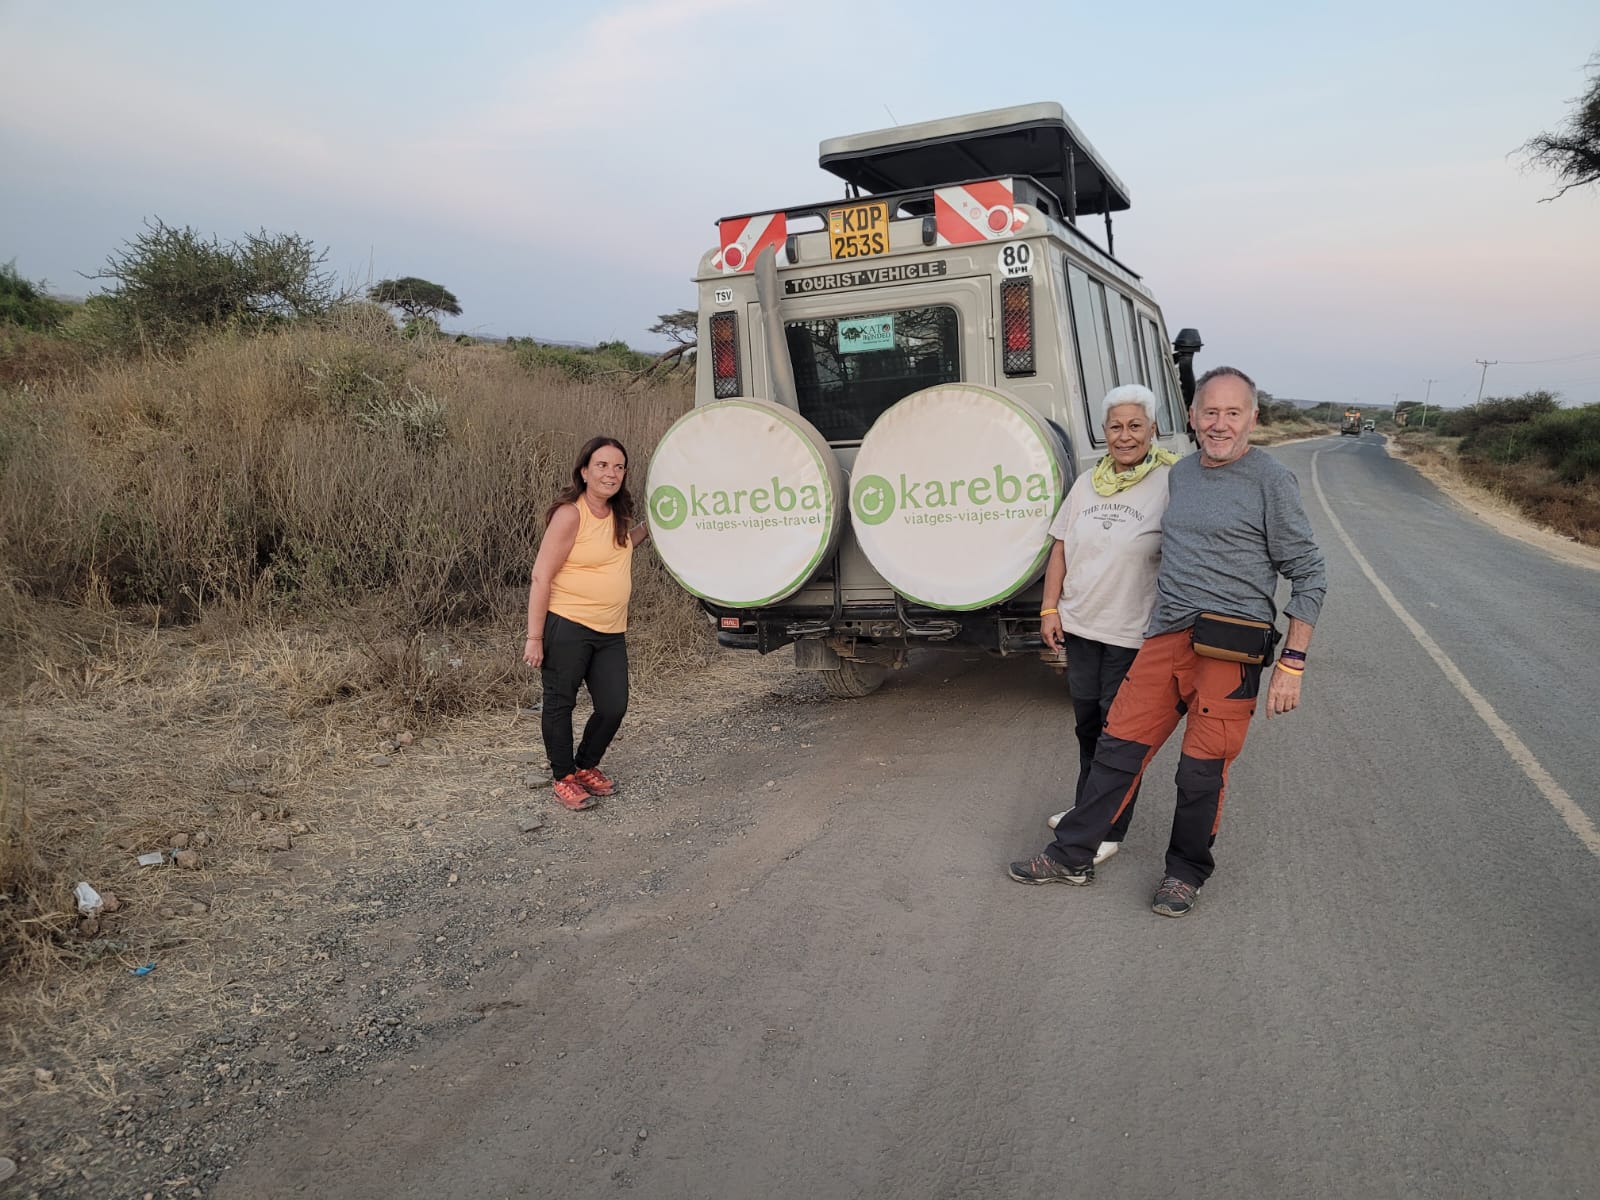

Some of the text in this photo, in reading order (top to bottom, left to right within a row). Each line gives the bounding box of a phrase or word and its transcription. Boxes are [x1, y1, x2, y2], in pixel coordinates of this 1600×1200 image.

[843, 206, 882, 233] KDP
[835, 232, 884, 259] 253S
[1003, 244, 1030, 267] 80
[792, 262, 940, 292] TOURIST VEHICLE
[1008, 265, 1028, 275] KPH
[716, 291, 731, 302] TSV
[690, 477, 822, 516] kareba
[900, 464, 1050, 509] kareba
[695, 512, 821, 532] viatges-viajes-travel
[904, 504, 1048, 526] viatges-viajes-travel
[1082, 503, 1144, 522] THE HAMPTONS
